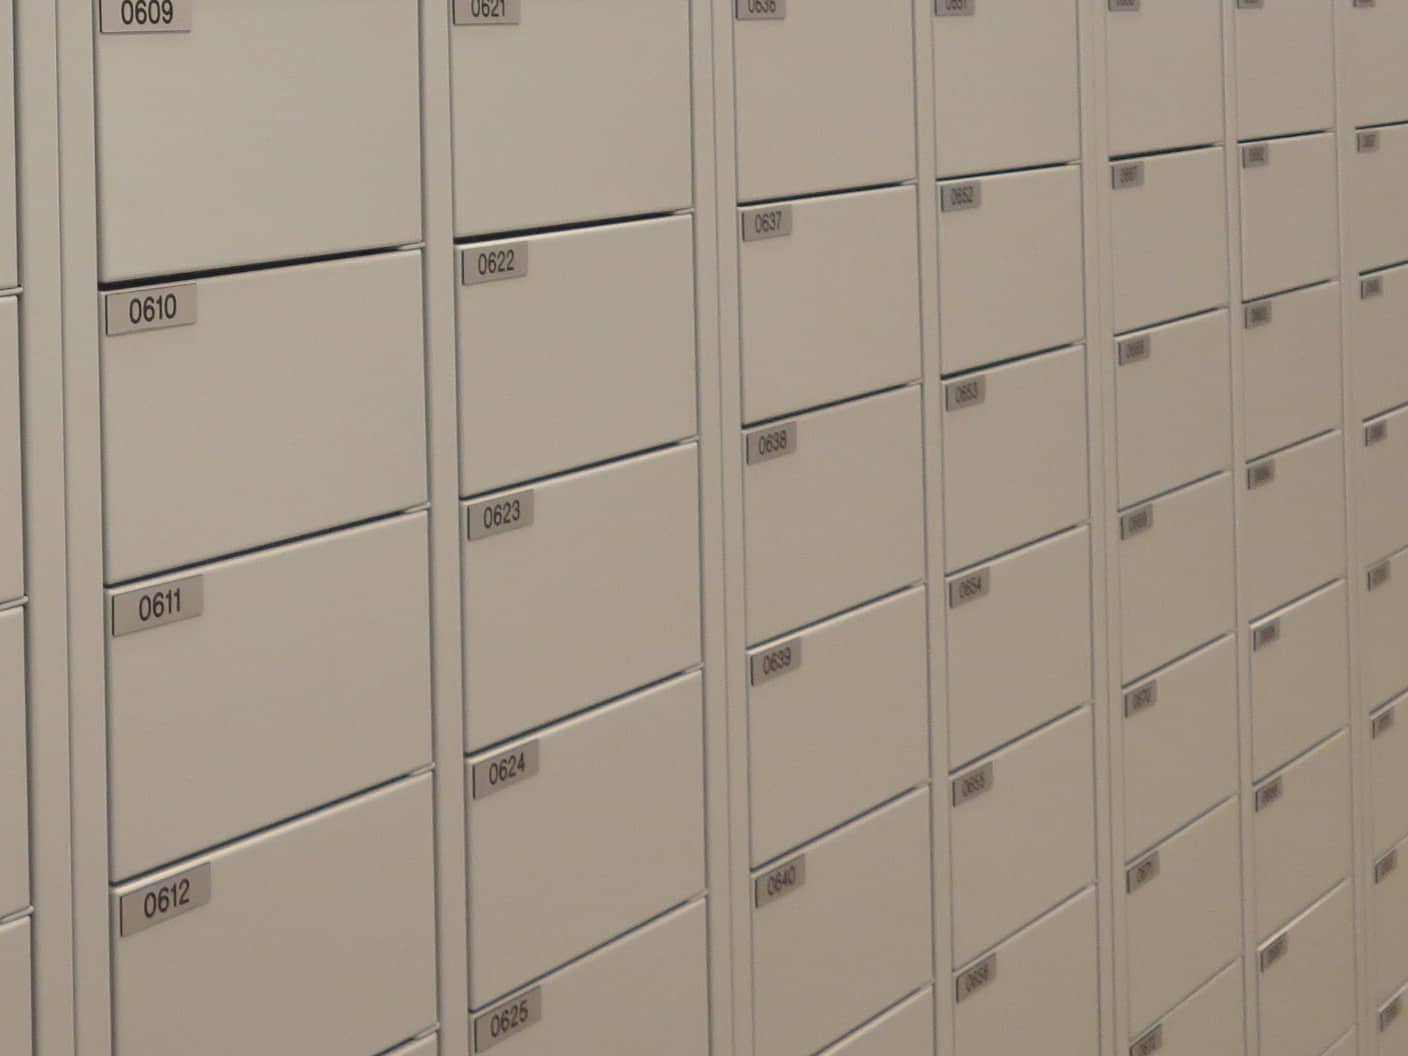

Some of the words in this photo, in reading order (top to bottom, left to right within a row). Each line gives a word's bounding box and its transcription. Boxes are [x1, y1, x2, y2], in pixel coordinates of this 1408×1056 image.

[121, 0, 173, 24] 0609
[755, 211, 782, 233] 0637
[479, 250, 514, 275] 0622
[130, 294, 176, 324] 0610
[759, 430, 787, 455] 0638
[484, 500, 520, 528] 0623
[139, 588, 180, 621] 0611
[763, 647, 791, 675] 0639
[489, 752, 525, 785] 0624
[766, 865, 796, 897] 0640
[144, 879, 189, 918] 0612
[490, 1001, 529, 1038] 0625
